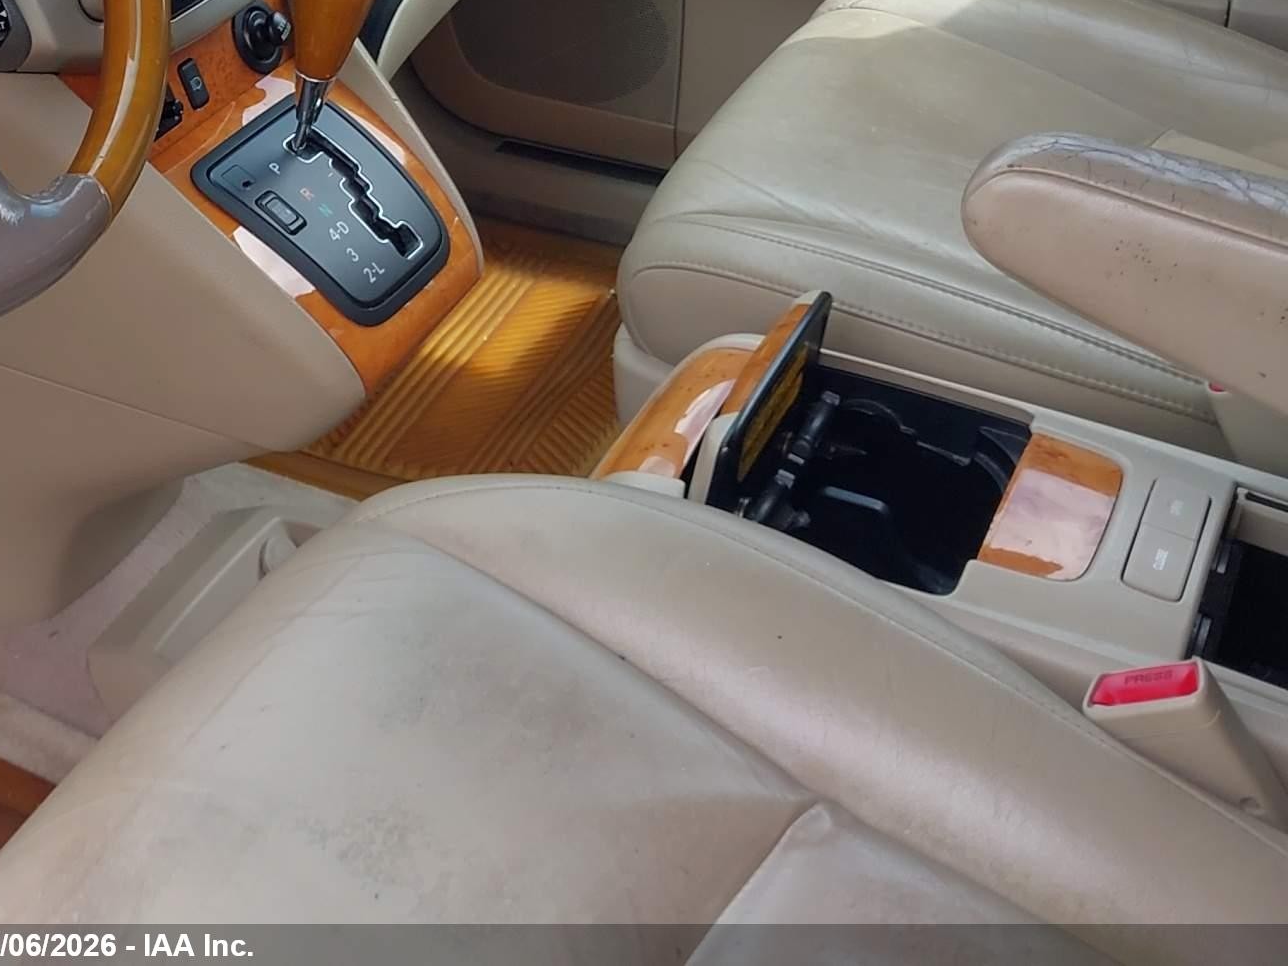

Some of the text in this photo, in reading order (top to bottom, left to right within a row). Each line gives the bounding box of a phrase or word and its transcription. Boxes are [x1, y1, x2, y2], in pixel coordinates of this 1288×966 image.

[268, 162, 281, 175] P
[300, 187, 314, 201] R
[328, 220, 350, 242] 4-D
[346, 247, 359, 262] 3
[363, 262, 385, 284] 2-L
[1124, 669, 1173, 685] PRESS
